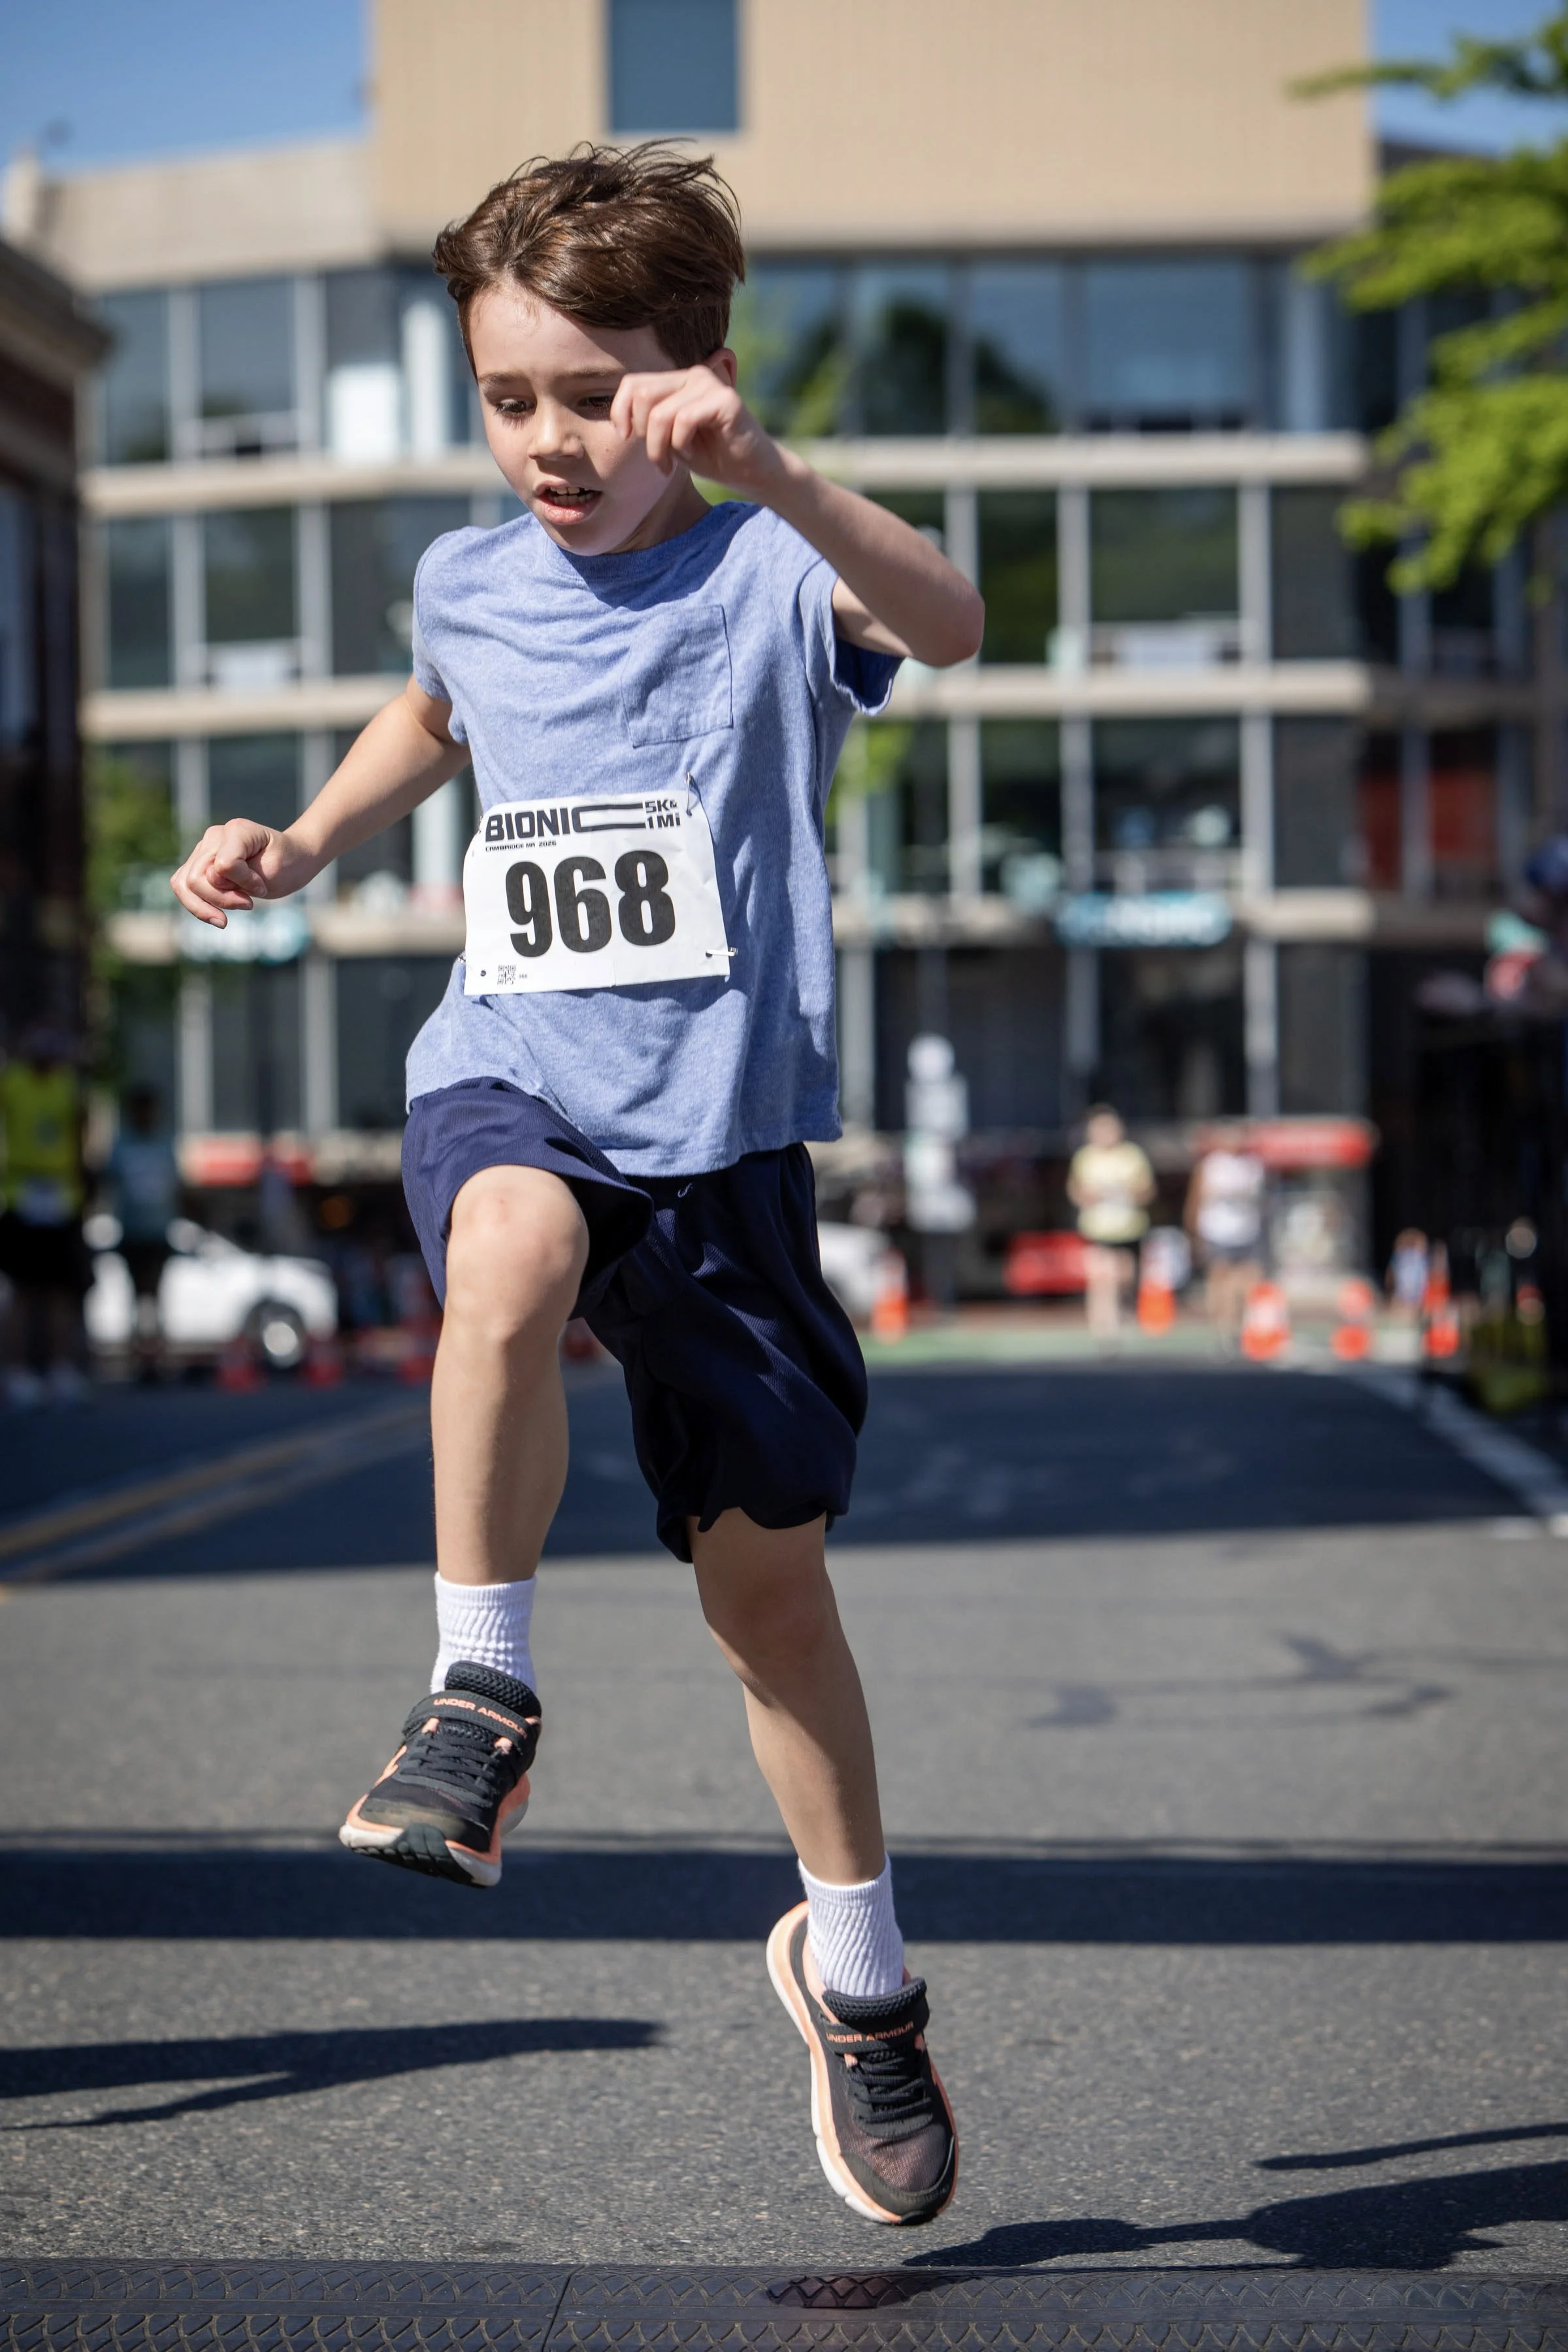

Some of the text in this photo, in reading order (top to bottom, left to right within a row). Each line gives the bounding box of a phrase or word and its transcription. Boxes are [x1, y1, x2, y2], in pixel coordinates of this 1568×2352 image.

[485, 802, 646, 842] BIONIC
[505, 850, 676, 958] 968
[433, 1698, 527, 1739] UNDER ARMOUR
[826, 2020, 914, 2043] UNDER ARMOUR
